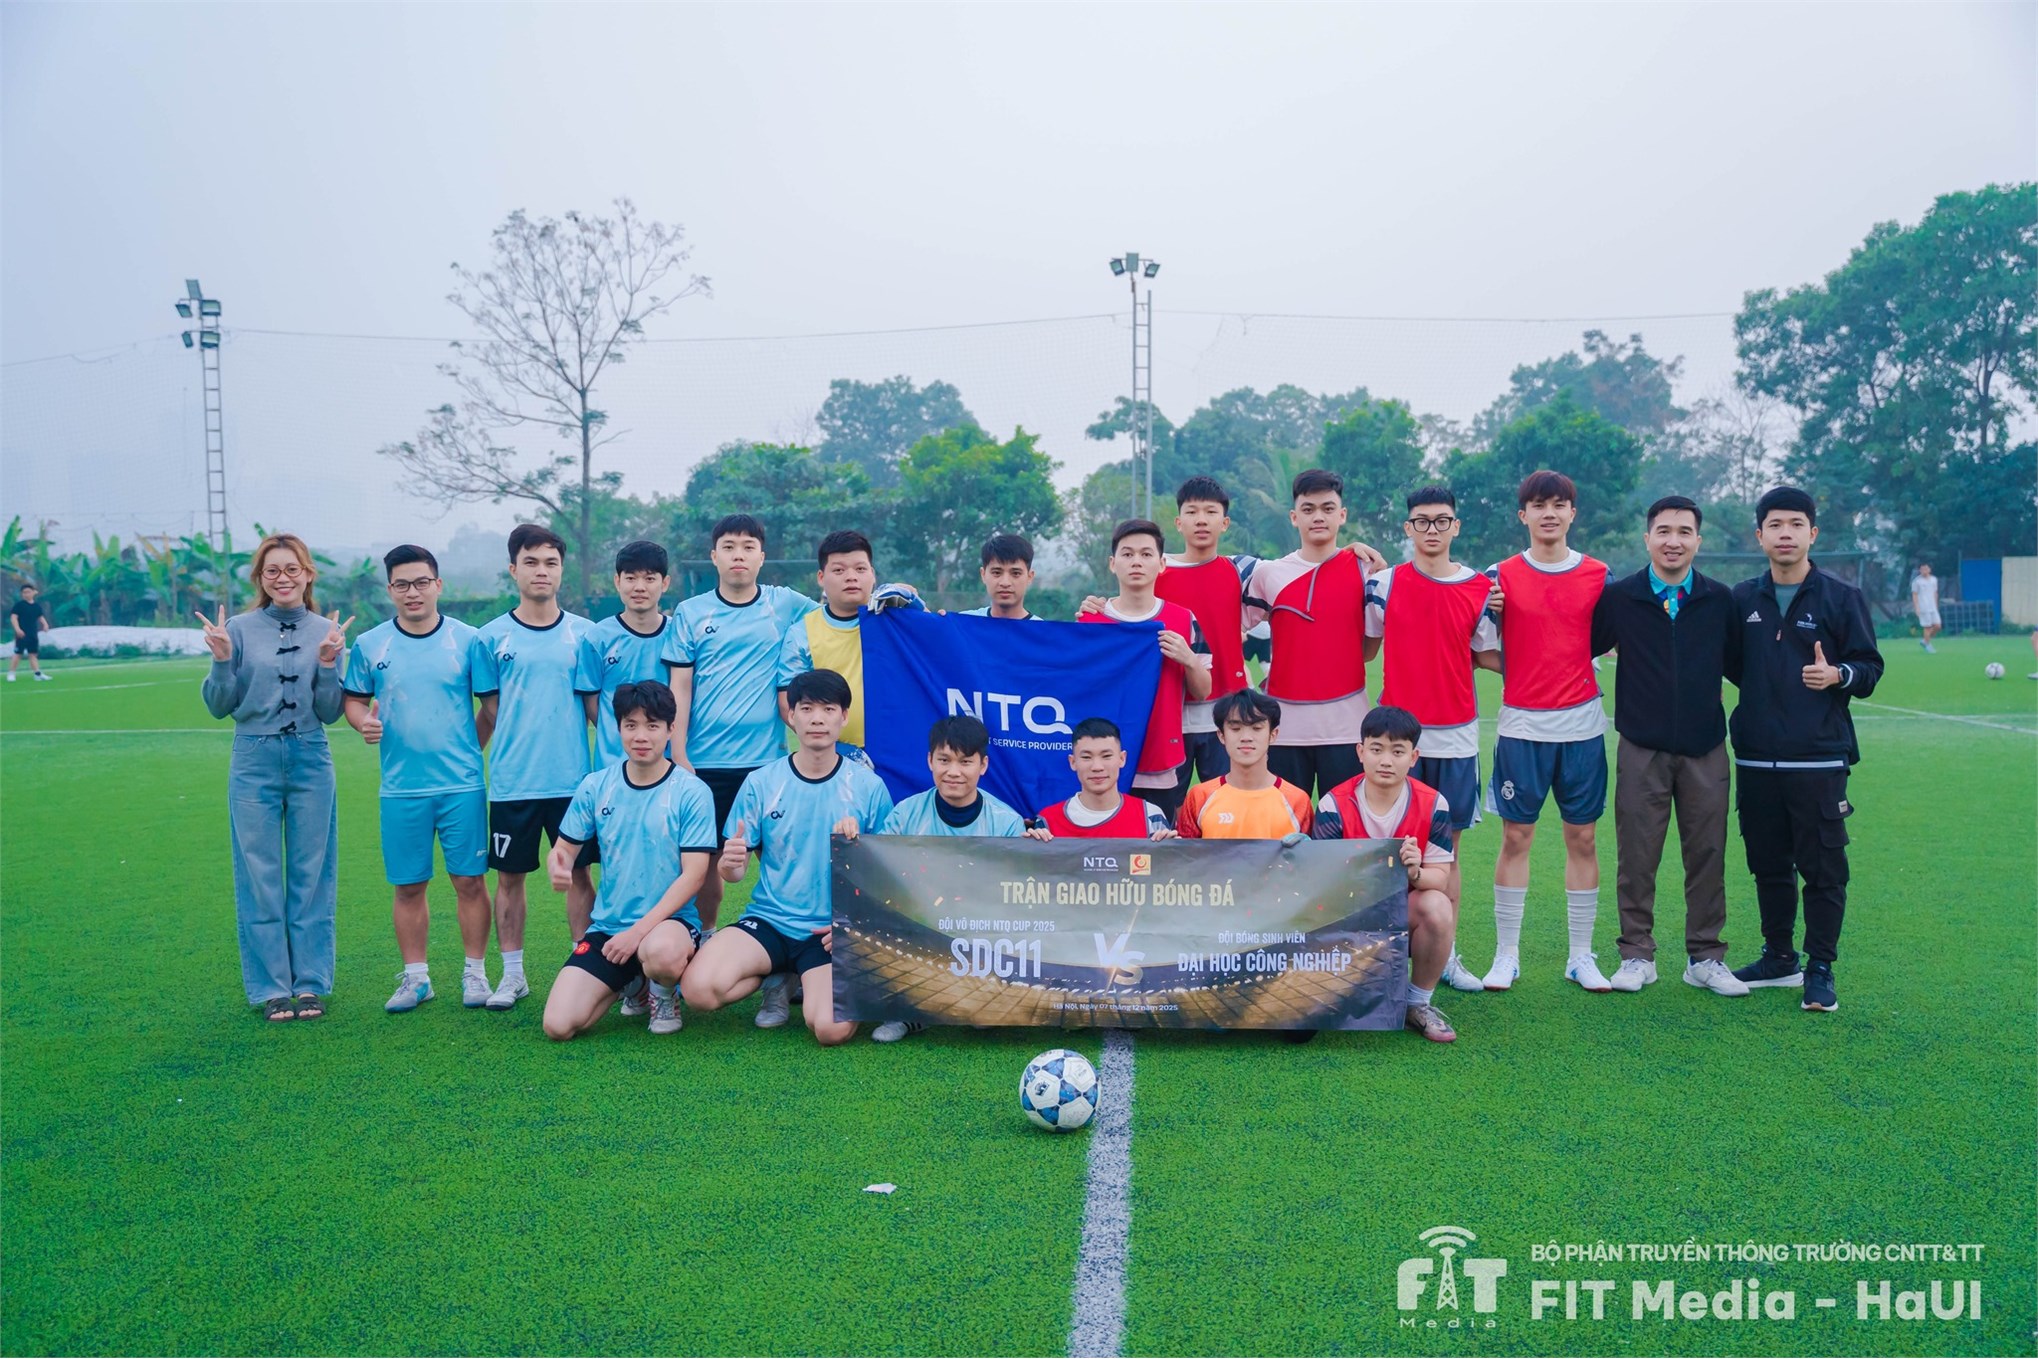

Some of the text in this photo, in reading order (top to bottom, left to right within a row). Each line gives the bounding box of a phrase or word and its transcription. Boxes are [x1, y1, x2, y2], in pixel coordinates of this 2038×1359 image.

[946, 688, 1073, 734] NTQ
[993, 737, 1027, 749] SERVICE
[1028, 742, 1073, 751] PROVIDER
[493, 832, 512, 858] 17
[1083, 857, 1119, 868] NTQ
[1000, 876, 1235, 909] TRẬN GIAO HỮU BÓNG ĐÁ
[938, 916, 1055, 933] ĐỘI VÔ ĐỊCH NTQ CUP 2025
[1218, 930, 1306, 946] ĐỘI BÓNG SINH VIÊN
[950, 937, 1042, 978] SDC11
[1177, 947, 1352, 976] ĐẠI HỌC CÔNG NGHIỆP
